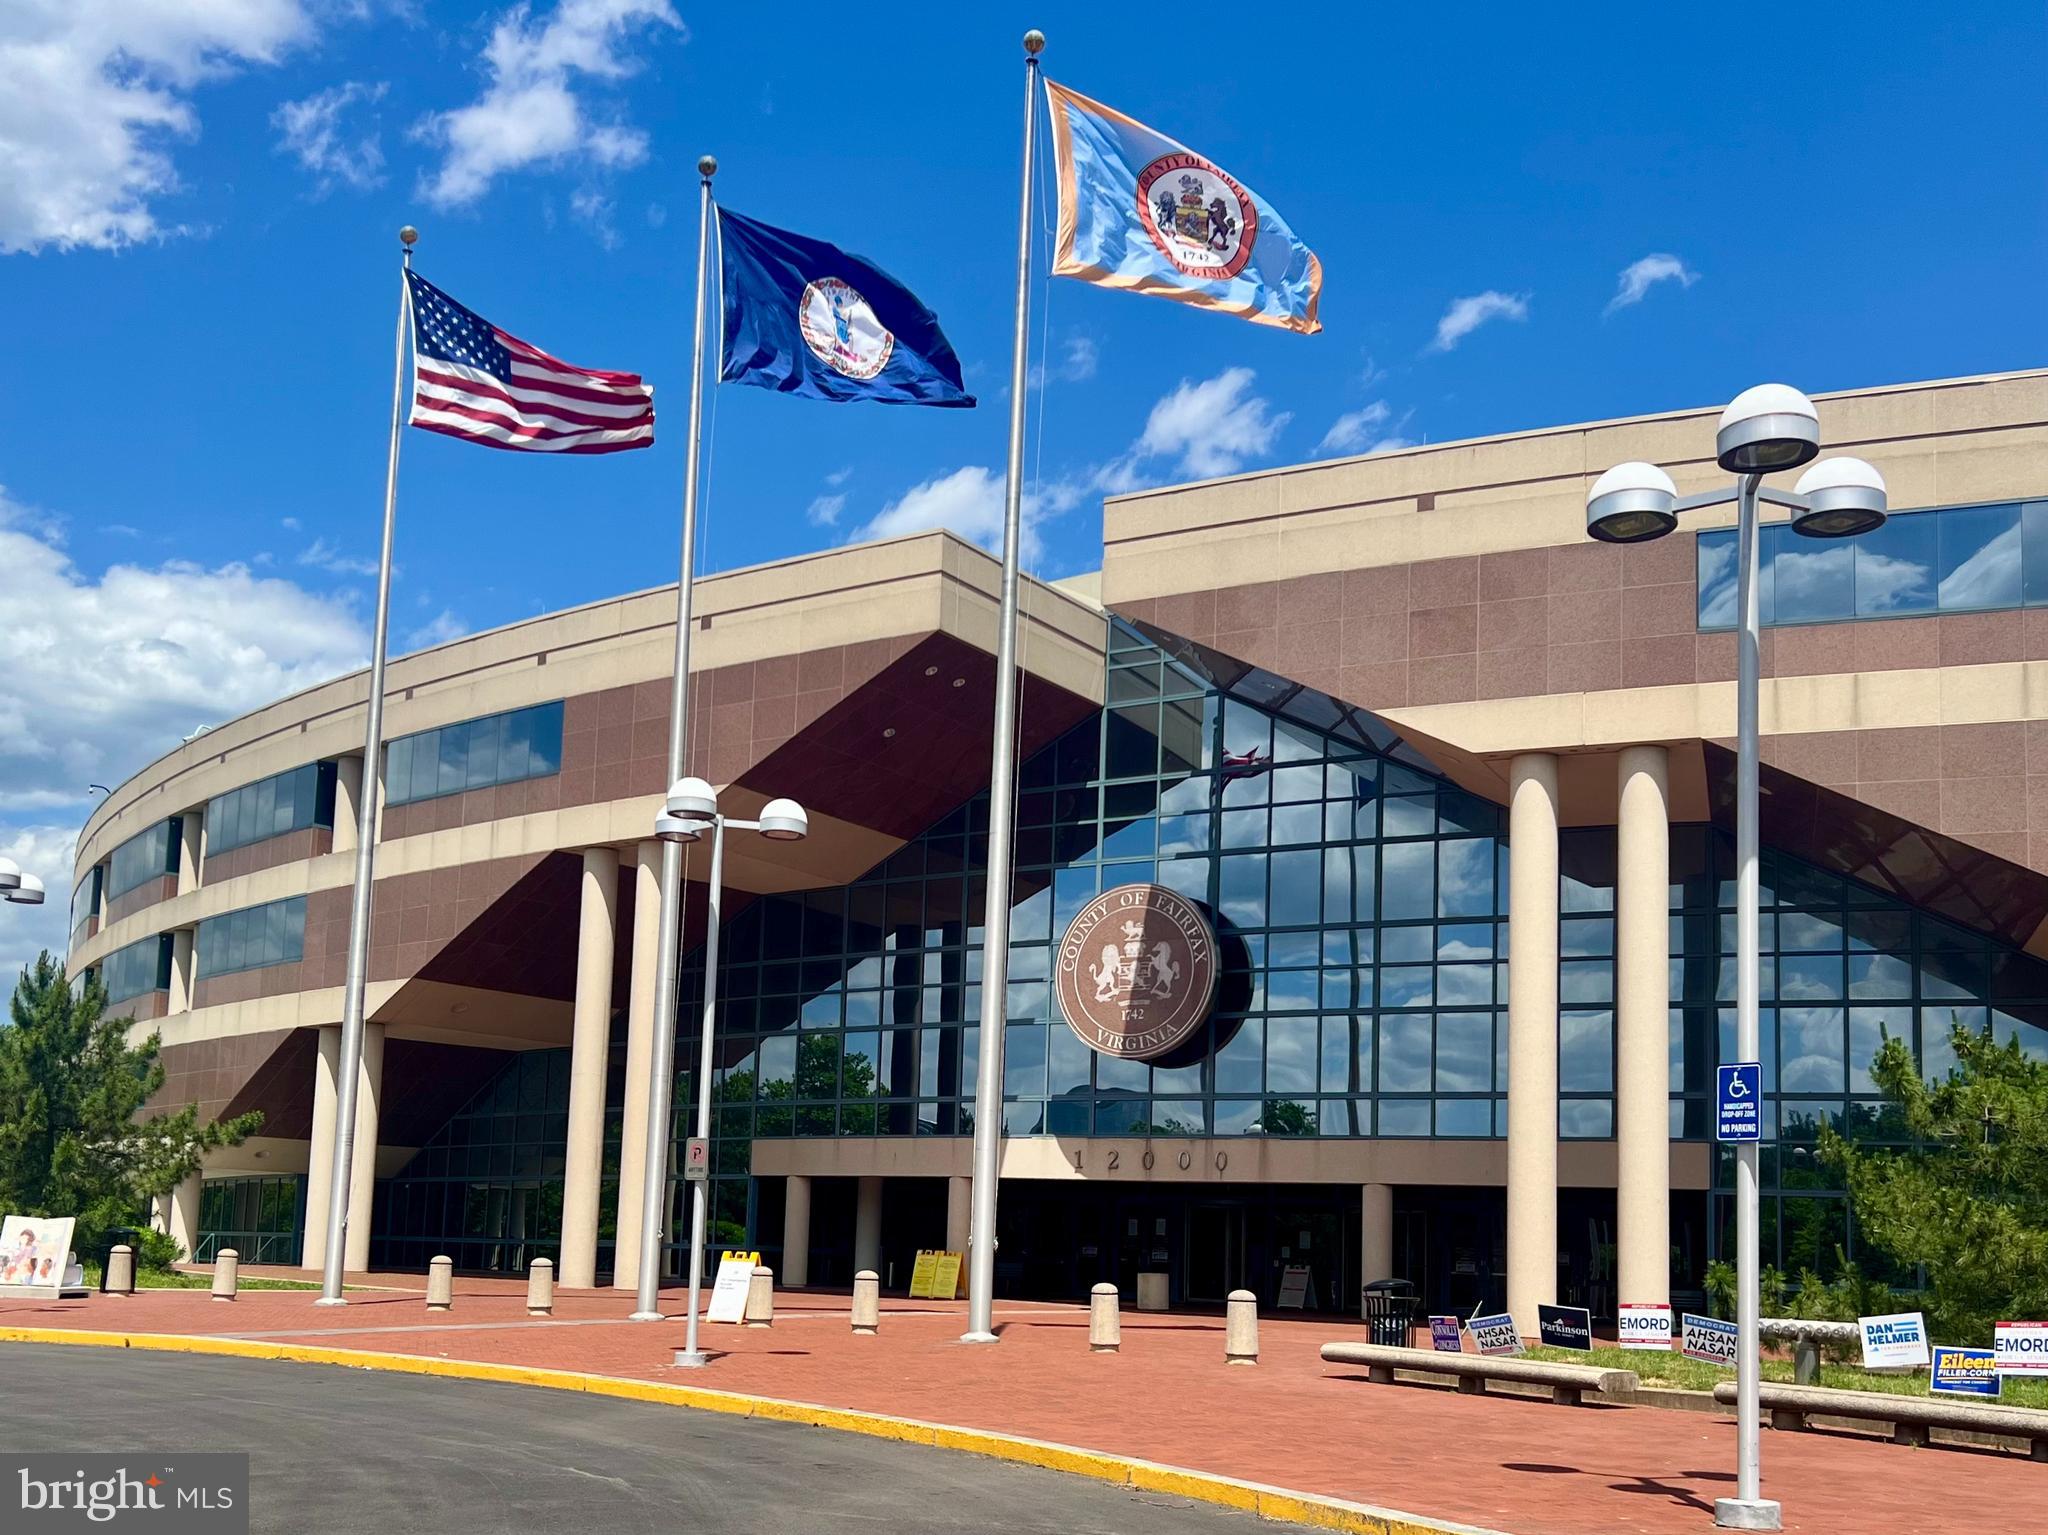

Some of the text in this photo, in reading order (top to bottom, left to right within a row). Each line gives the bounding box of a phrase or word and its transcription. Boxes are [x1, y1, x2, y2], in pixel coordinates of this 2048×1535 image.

[1062, 892, 1207, 972] COUNTY OF FAIRFAX
[1121, 1009, 1144, 1021] 1742
[1096, 1023, 1178, 1050] VIRGINIA
[1721, 1110, 1744, 1118] DROP-OFF
[1721, 1123, 1756, 1133] NO PARKING
[1074, 1149, 1228, 1171] 12000
[1471, 1317, 1509, 1328] DEMOCRAT
[1541, 1321, 1588, 1336] Parkinson
[1620, 1317, 1670, 1330] EMORD
[1687, 1317, 1736, 1332] DEMOCRAT
[1866, 1323, 1893, 1334] DAN
[1477, 1325, 1514, 1340] AHSAN
[1686, 1328, 1737, 1347] AHSAN
[1868, 1332, 1920, 1345] HELMER
[1480, 1335, 1518, 1348] NASAR
[1687, 1339, 1736, 1359] NASAR
[1939, 1353, 1995, 1369] Eileen
[1938, 1369, 1996, 1377] FILLER-CORN
